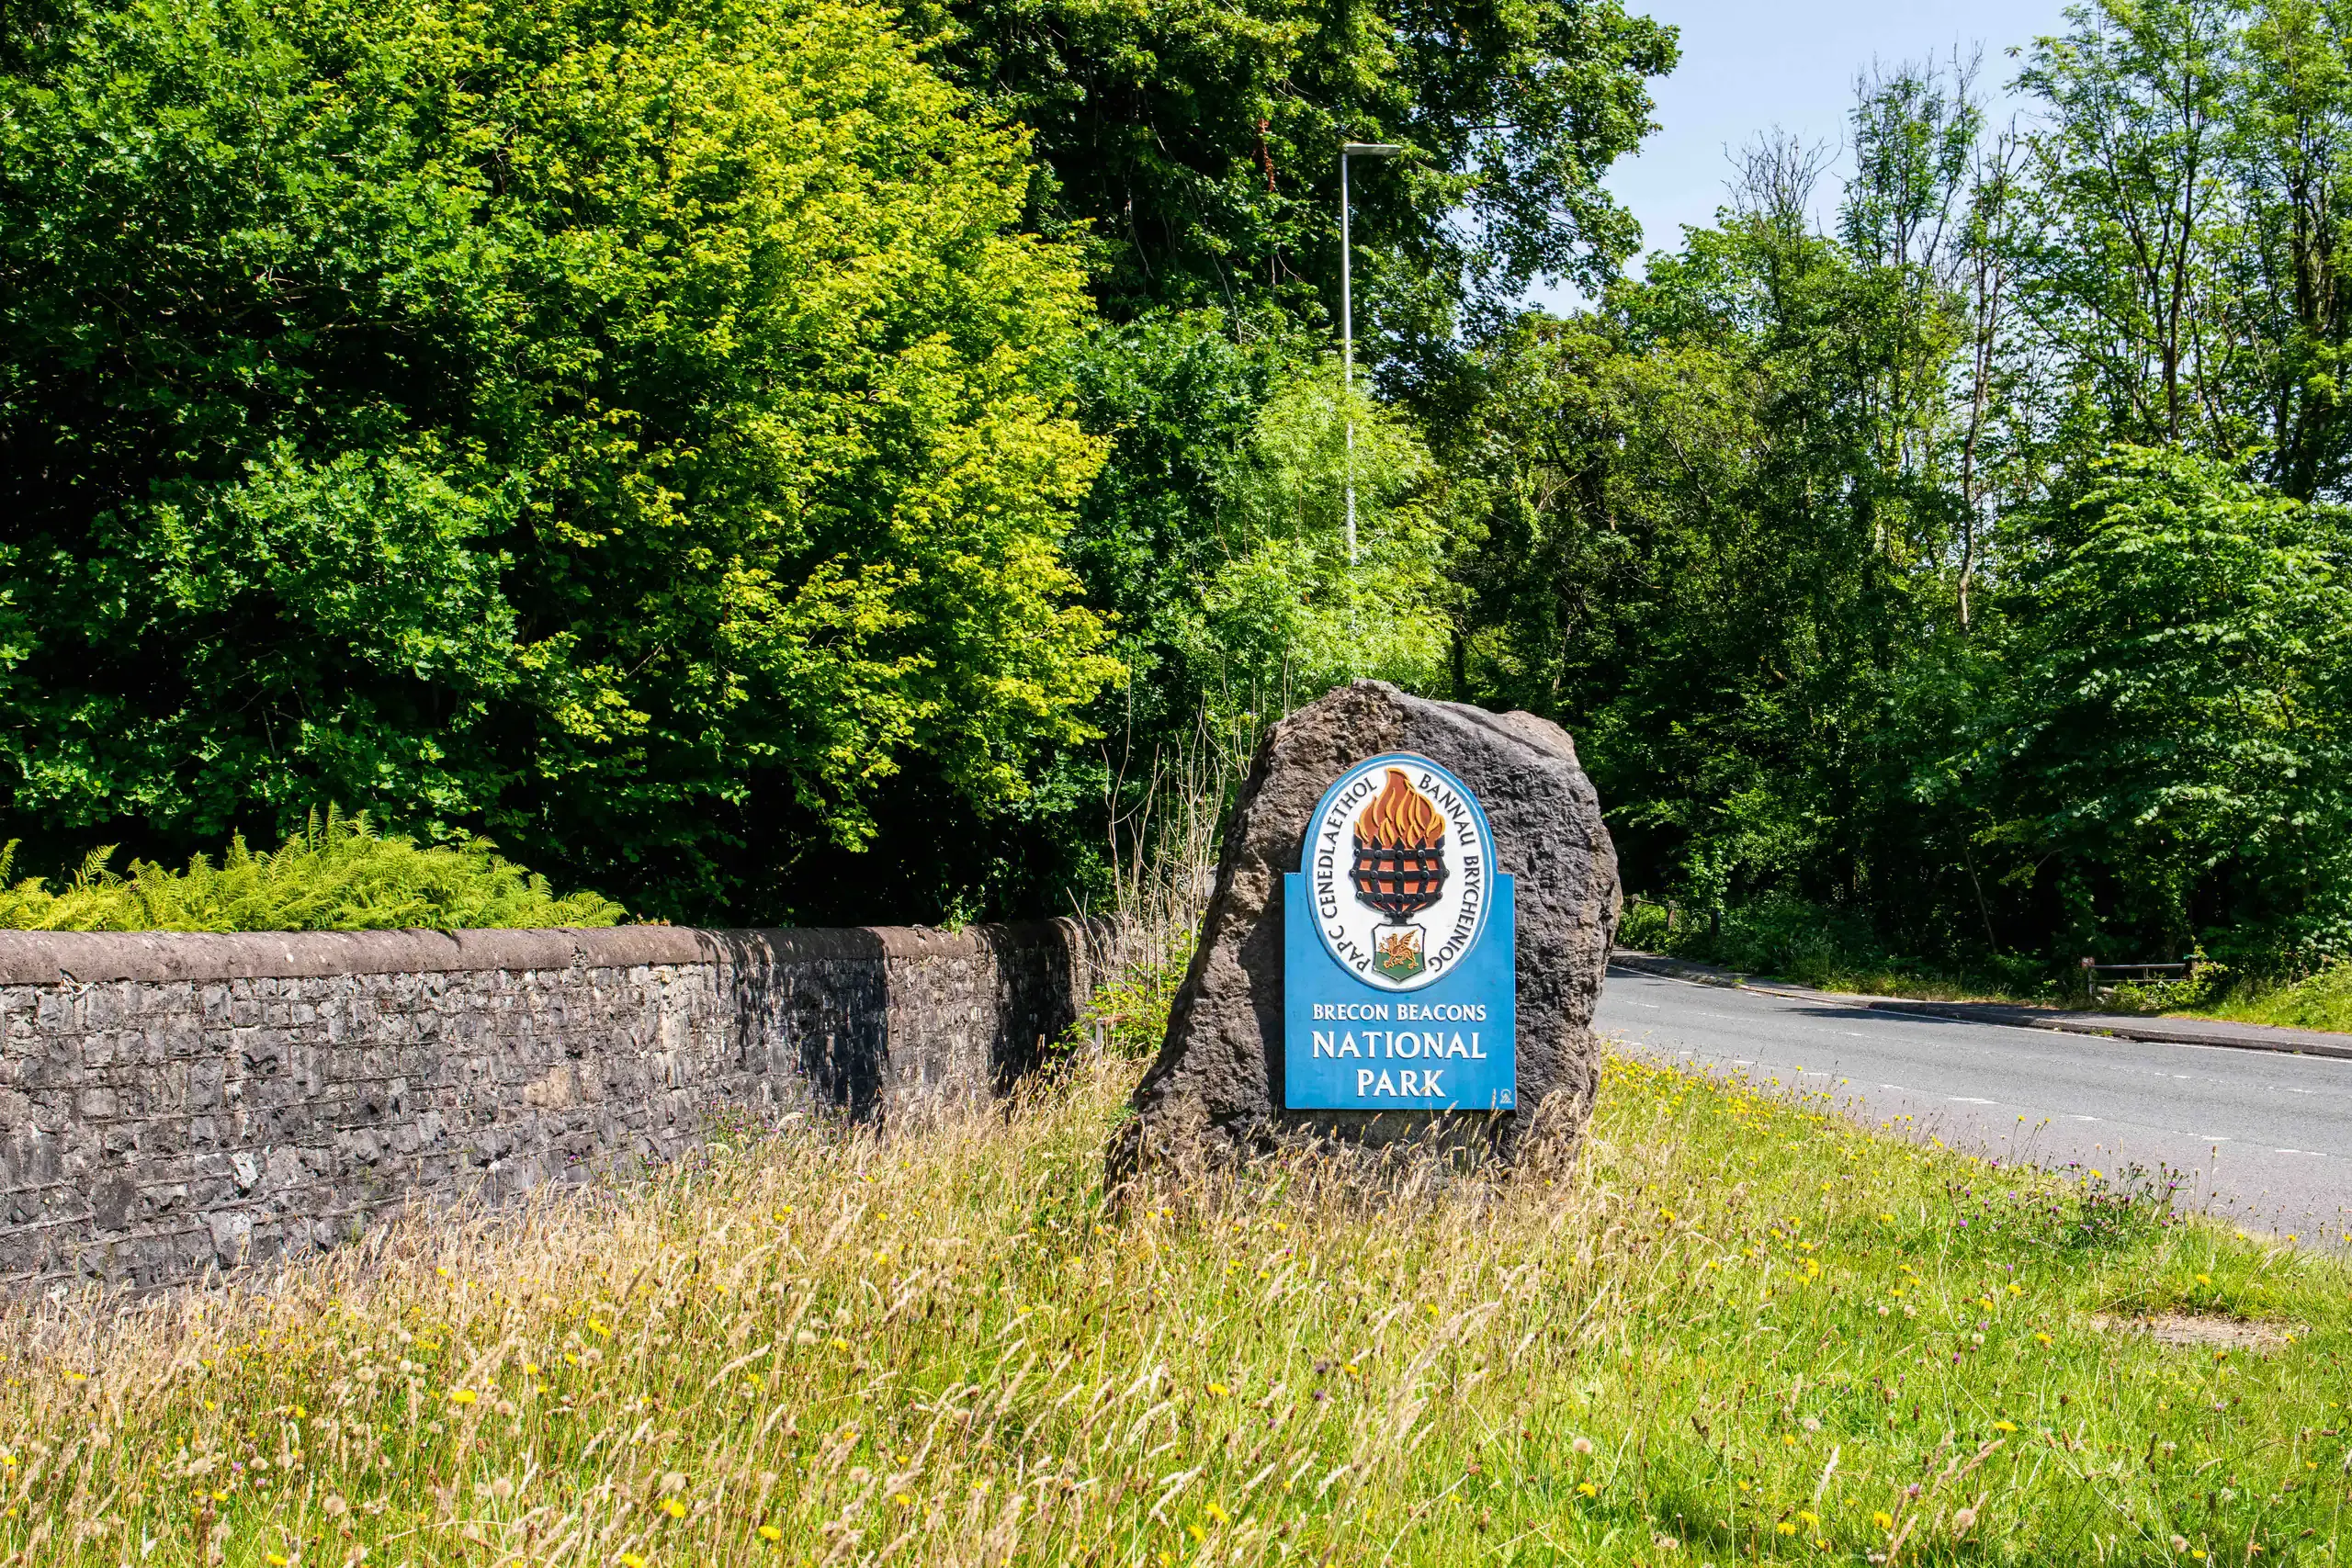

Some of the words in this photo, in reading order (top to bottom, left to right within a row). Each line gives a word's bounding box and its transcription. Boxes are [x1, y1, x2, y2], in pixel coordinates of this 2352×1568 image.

[1418, 773, 1476, 848] BANNAU
[1317, 776, 1378, 919] CENEDLAETHOL
[1427, 854, 1481, 973] BRYCHEINIOG
[1312, 1003, 1388, 1021] BRECON
[1396, 1003, 1487, 1022] BEACONS
[1311, 1031, 1487, 1059] NATIONAL
[1356, 1068, 1446, 1098] PARK
